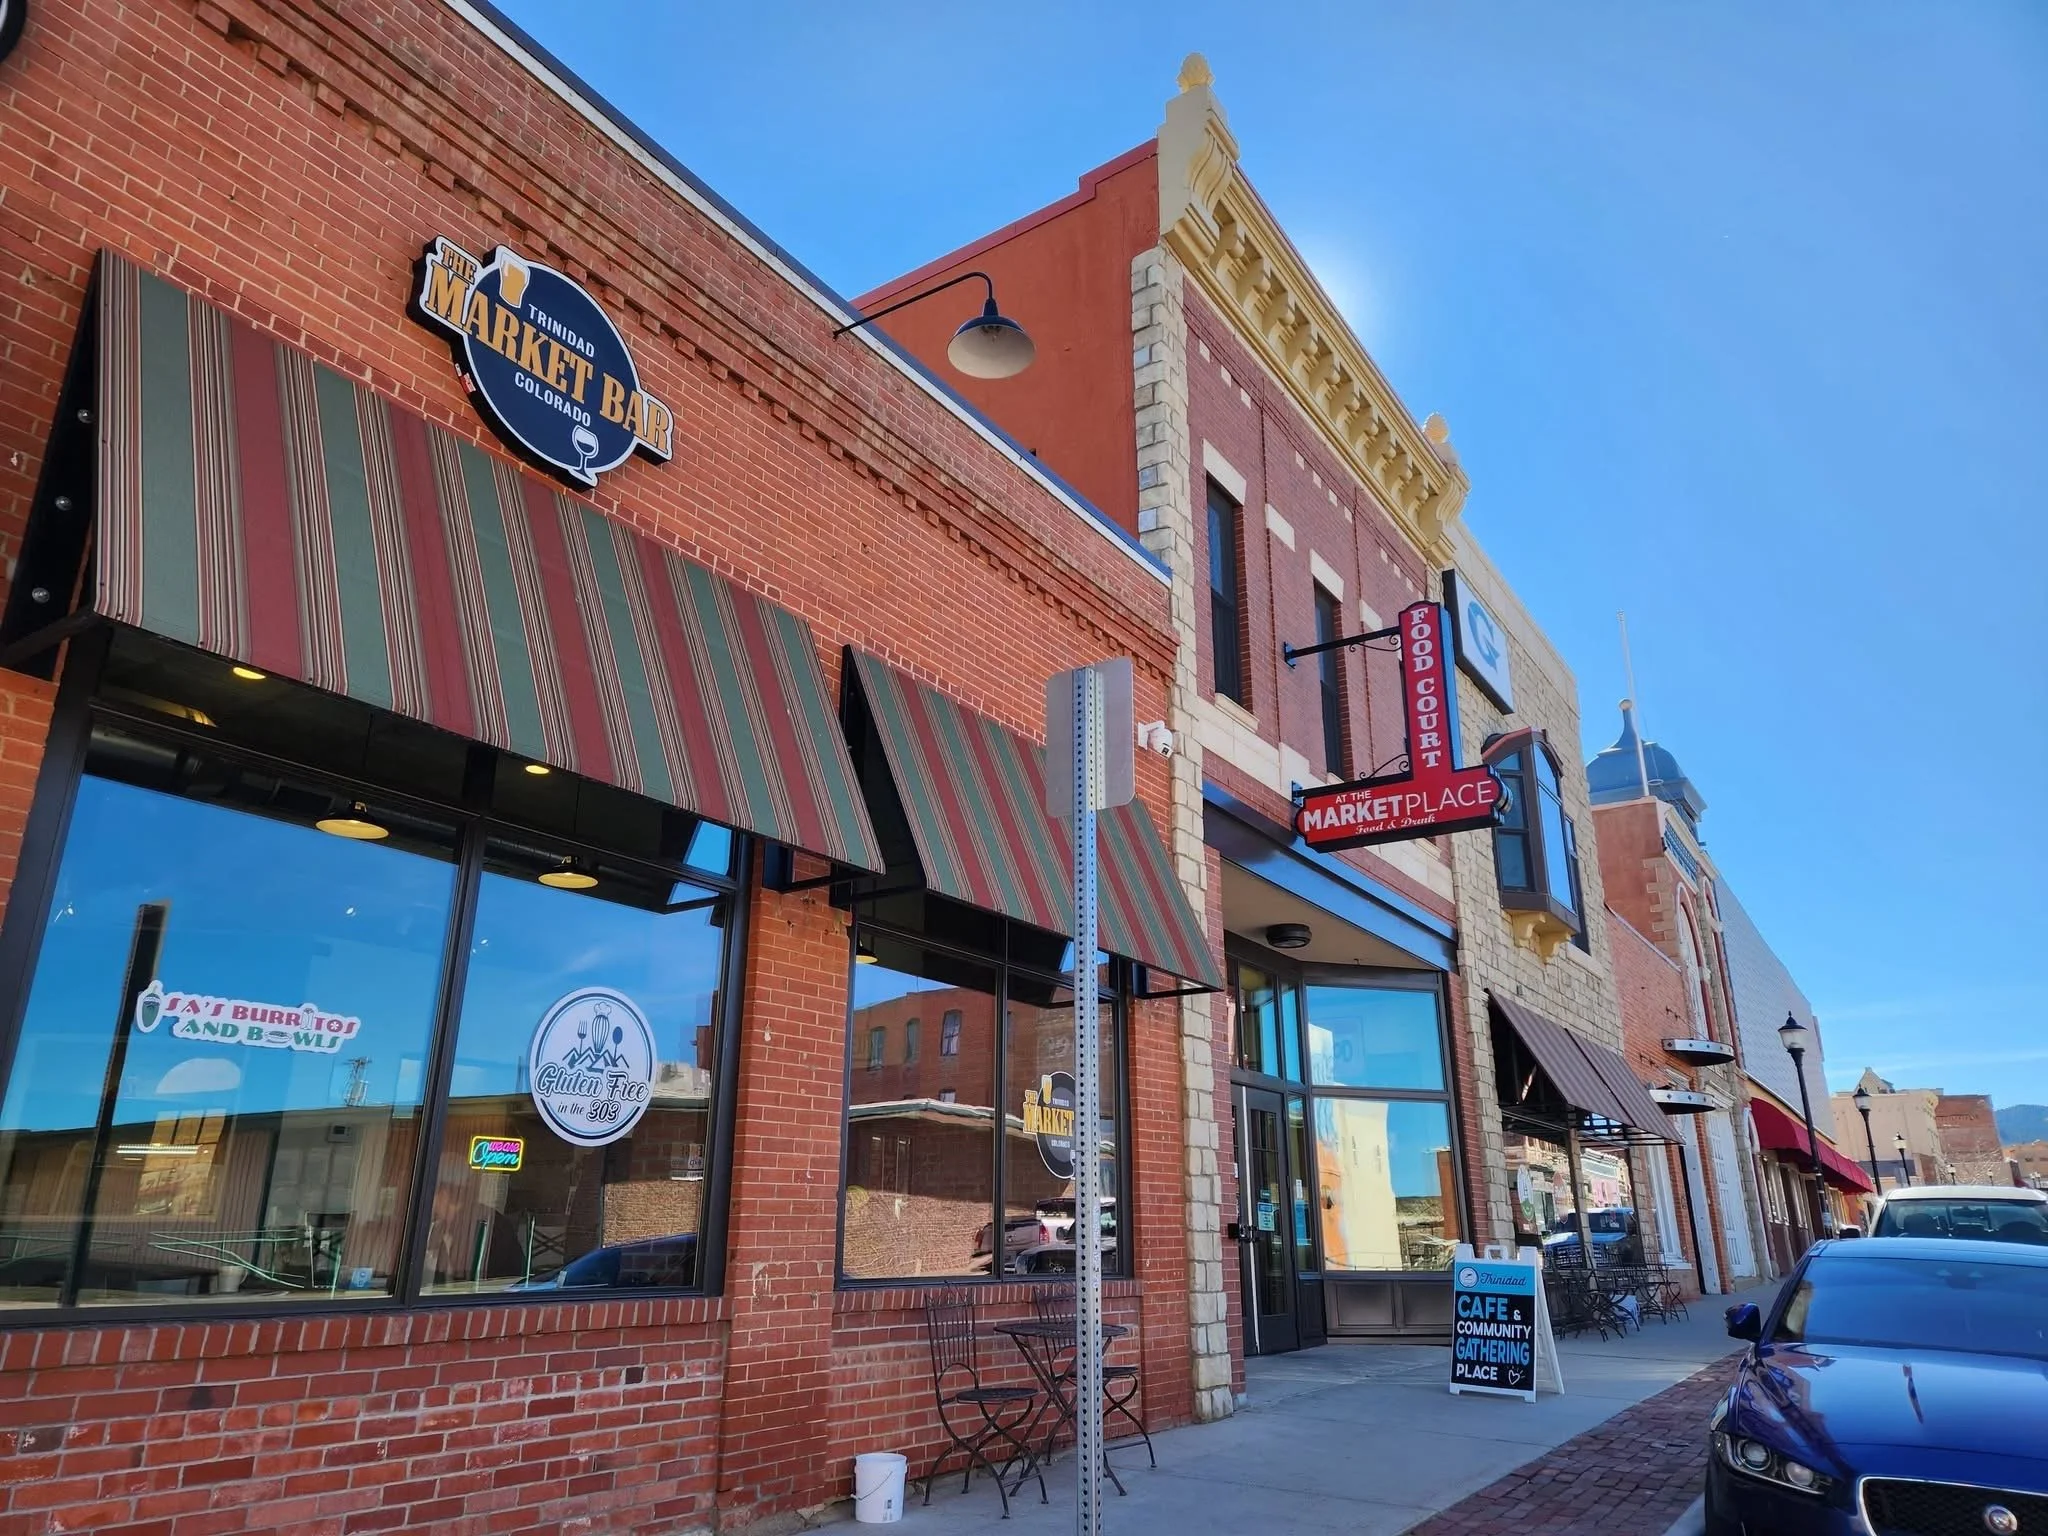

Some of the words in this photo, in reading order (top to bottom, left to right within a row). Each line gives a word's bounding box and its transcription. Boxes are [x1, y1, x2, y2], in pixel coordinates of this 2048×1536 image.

[441, 244, 476, 284] THE
[528, 303, 595, 358] TRINIDAD
[425, 264, 595, 405] MARKET
[600, 371, 669, 454] BAR
[515, 371, 592, 428] COLORADO
[1411, 607, 1436, 673] FOOD
[1416, 677, 1441, 769] COURT
[1303, 780, 1494, 833] MARKETPLACE
[1335, 795, 1347, 805] AT
[1351, 790, 1372, 802] THE
[1355, 822, 1384, 835] Food
[1387, 819, 1396, 829] &
[165, 997, 225, 1017] SA'S
[180, 1018, 240, 1038] AND
[536, 1062, 602, 1098] Gluten
[607, 1070, 648, 1102] Free
[557, 1102, 567, 1114] in
[569, 1102, 585, 1116] the
[586, 1099, 620, 1123] 303
[1023, 1104, 1074, 1136] MARKET
[473, 1141, 518, 1168] Open
[1480, 1272, 1527, 1286] Trinidad
[1457, 1294, 1509, 1321] CAFE
[1513, 1309, 1521, 1320] &
[1456, 1320, 1532, 1340] COMMUNITY
[1455, 1337, 1530, 1366] GATHERING
[1456, 1363, 1498, 1381] PLACE
